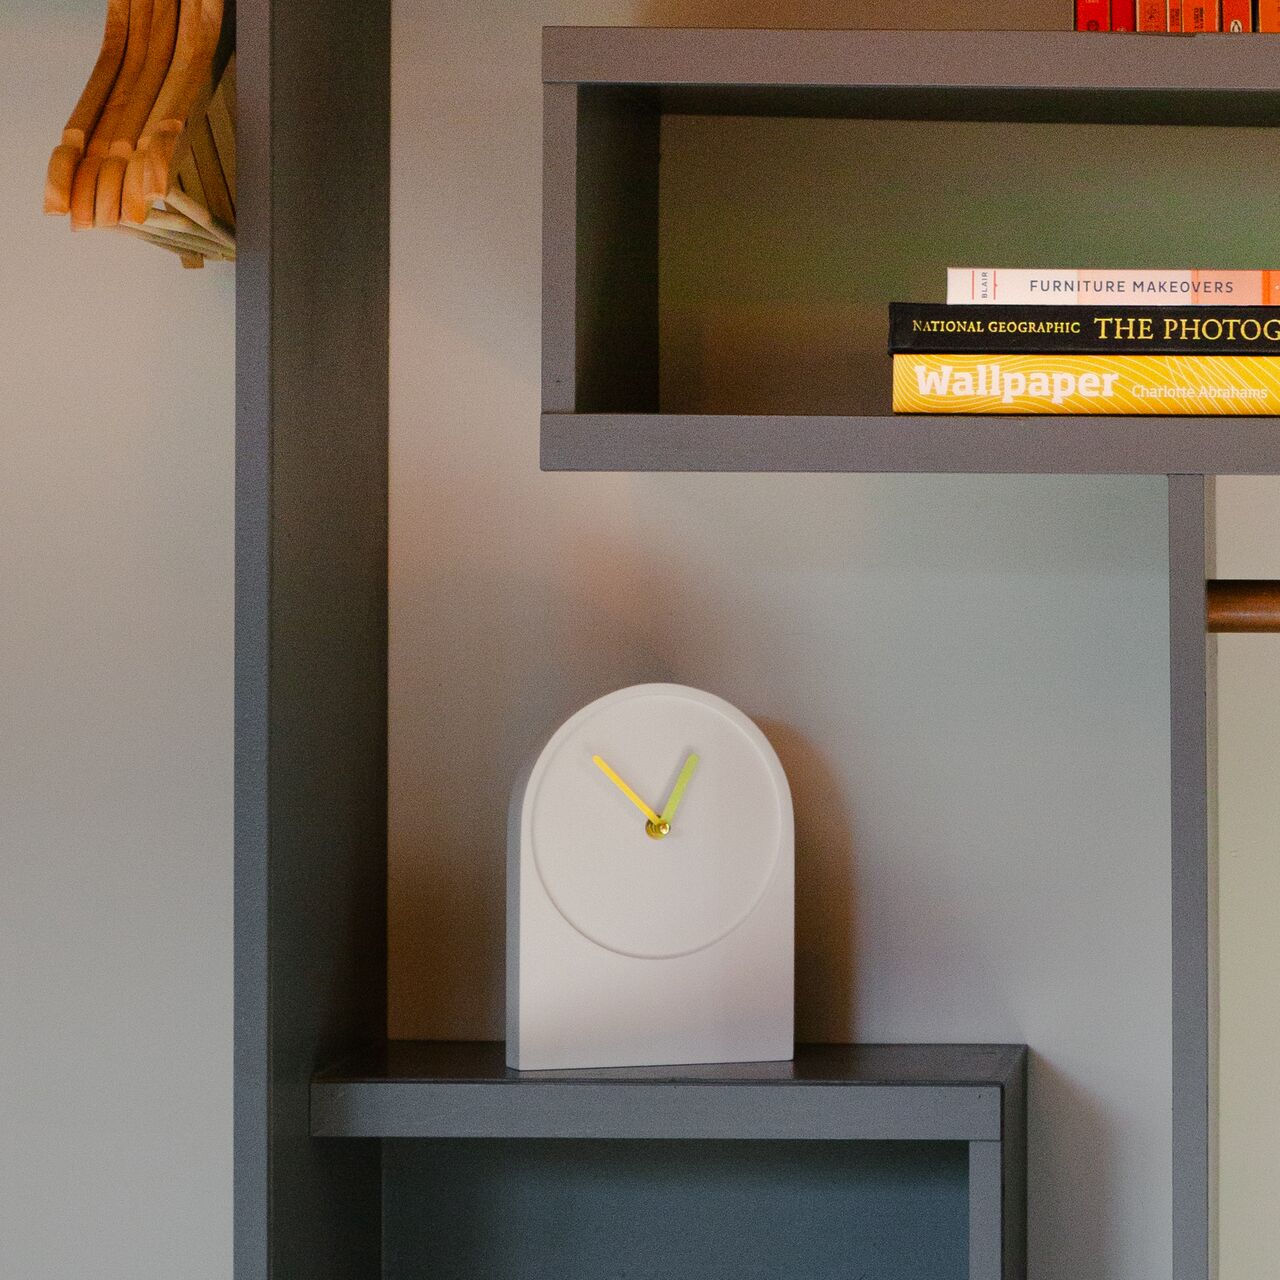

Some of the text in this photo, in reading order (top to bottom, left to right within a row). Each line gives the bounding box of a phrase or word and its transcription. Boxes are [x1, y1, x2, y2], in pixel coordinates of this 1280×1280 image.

[1030, 280, 1234, 293] FURNITURE MAKEOVERS
[912, 320, 1080, 334] NATIONAL GEOGRAPHIC
[1094, 318, 1153, 340] THE
[914, 364, 1119, 404] Wallpaper
[1132, 384, 1268, 399] Charlotte Abrahams
